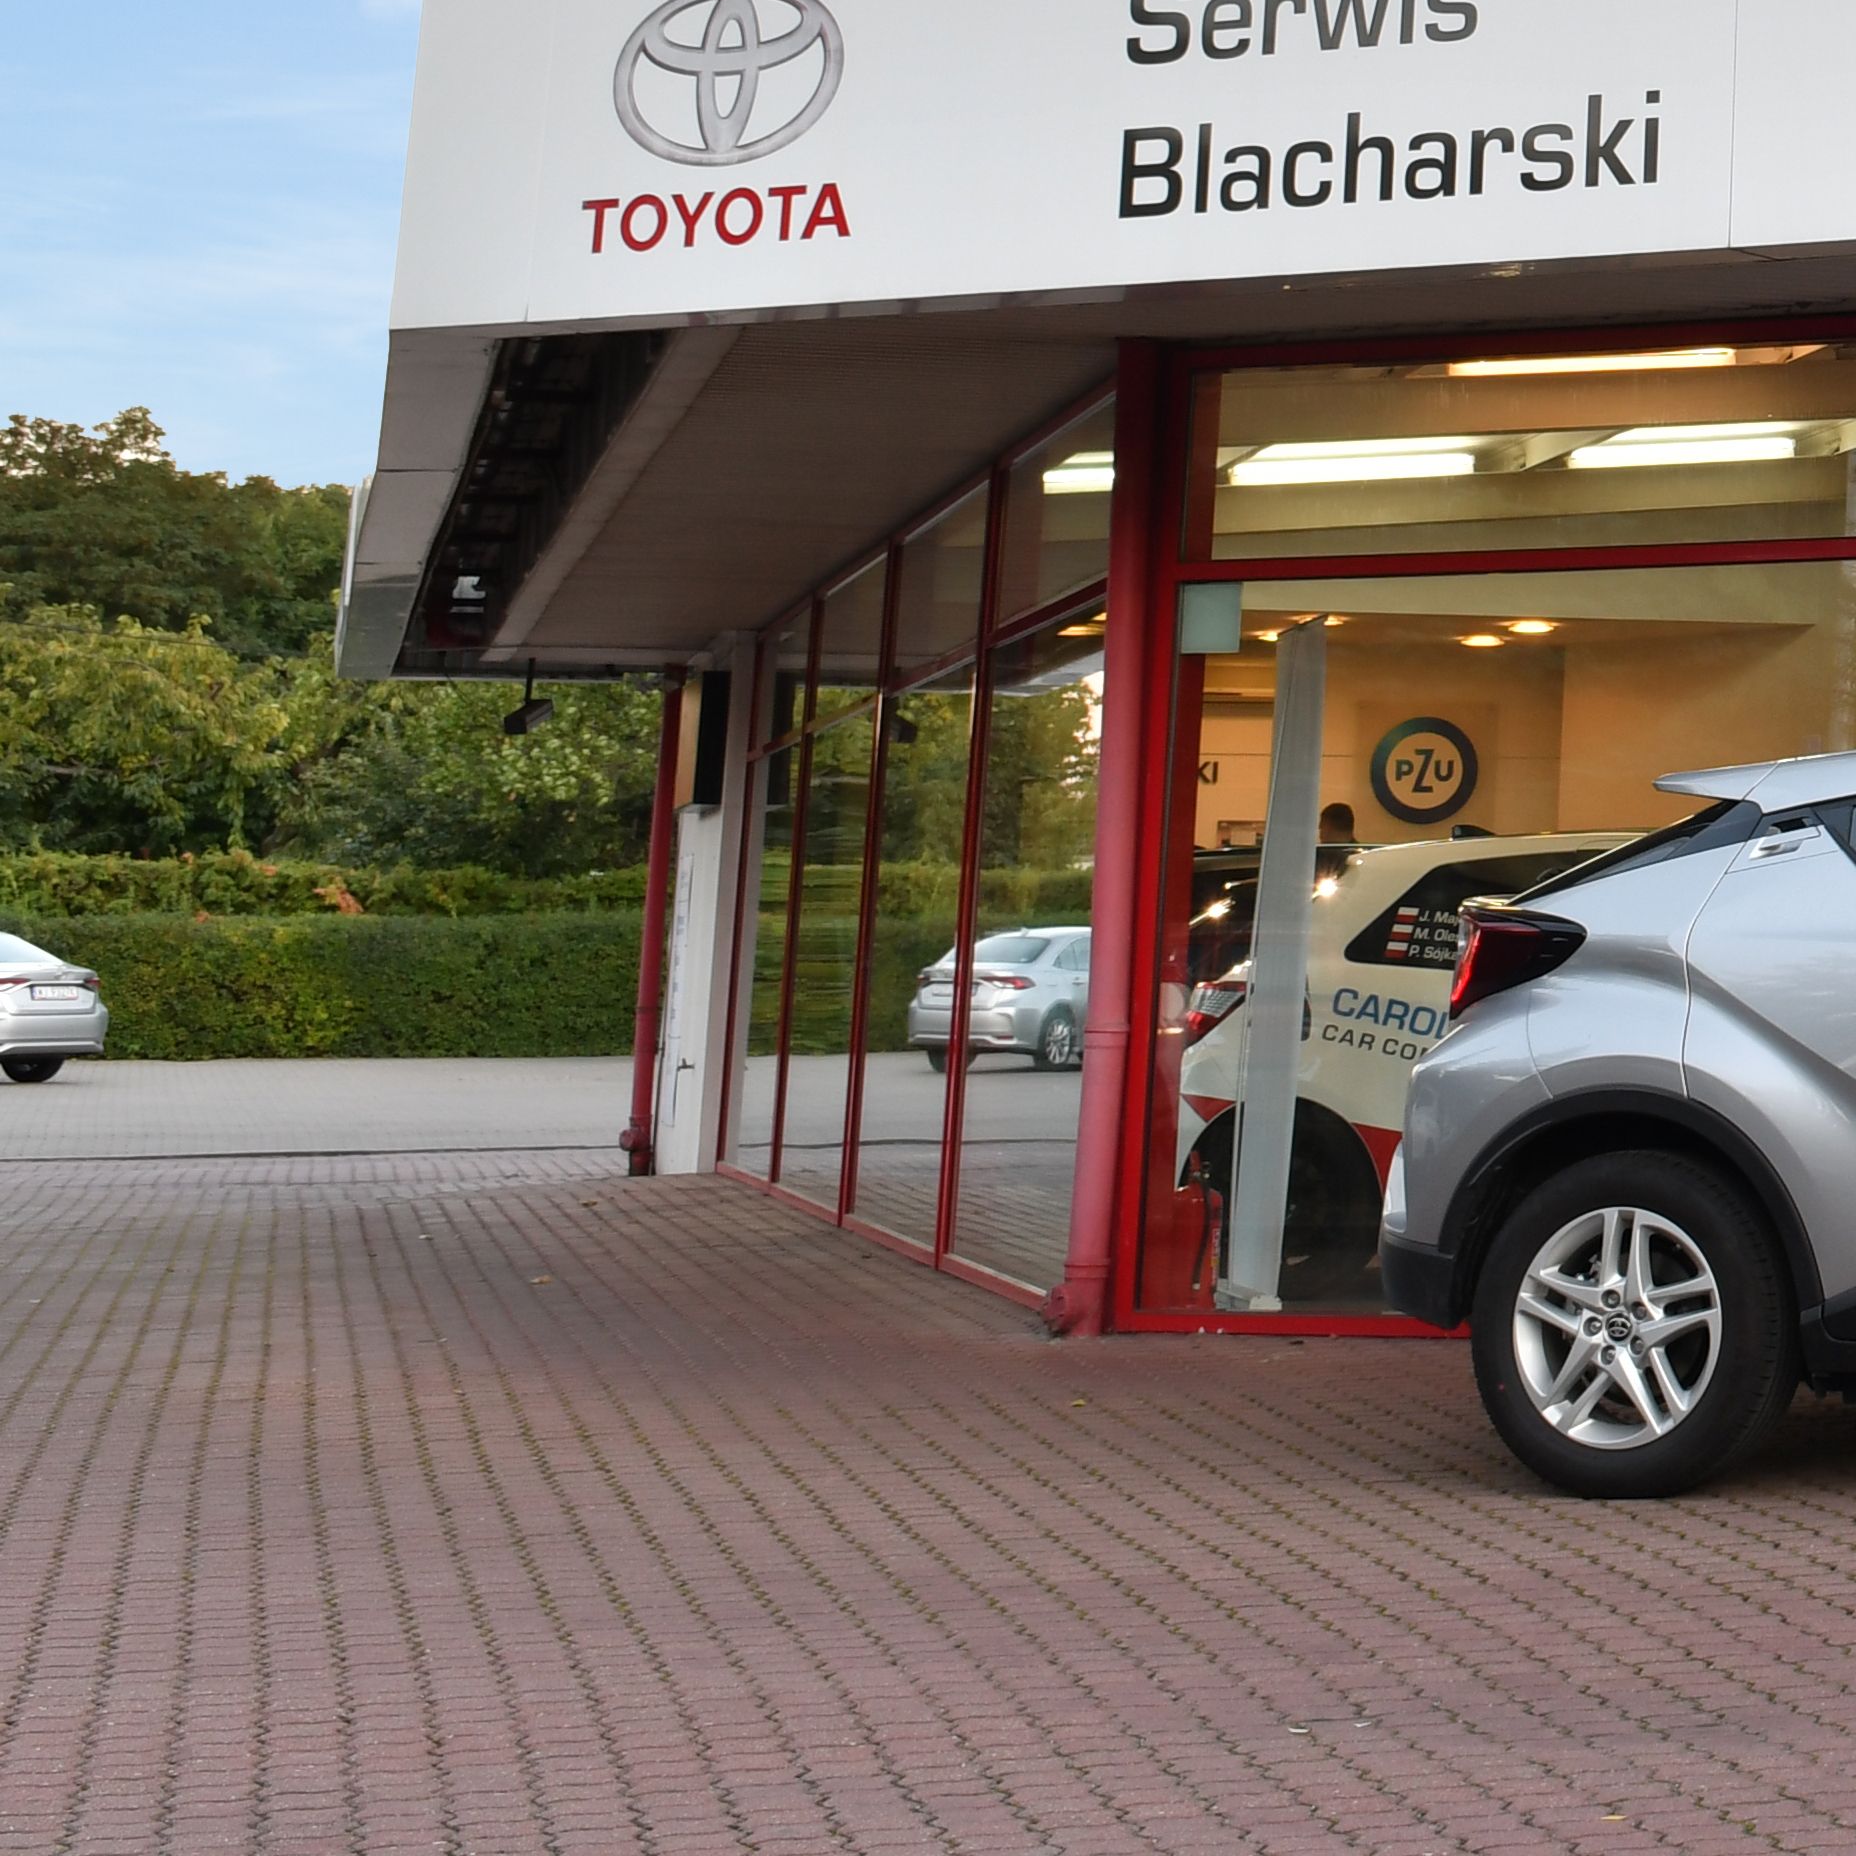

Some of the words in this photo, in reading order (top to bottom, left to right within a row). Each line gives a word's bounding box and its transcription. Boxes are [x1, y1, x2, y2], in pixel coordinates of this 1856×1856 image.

[1117, 90, 1661, 219] Blacharski
[583, 183, 850, 253] TOYOTA
[1395, 748, 1454, 793] PZU
[1322, 1024, 1376, 1051] CAR
